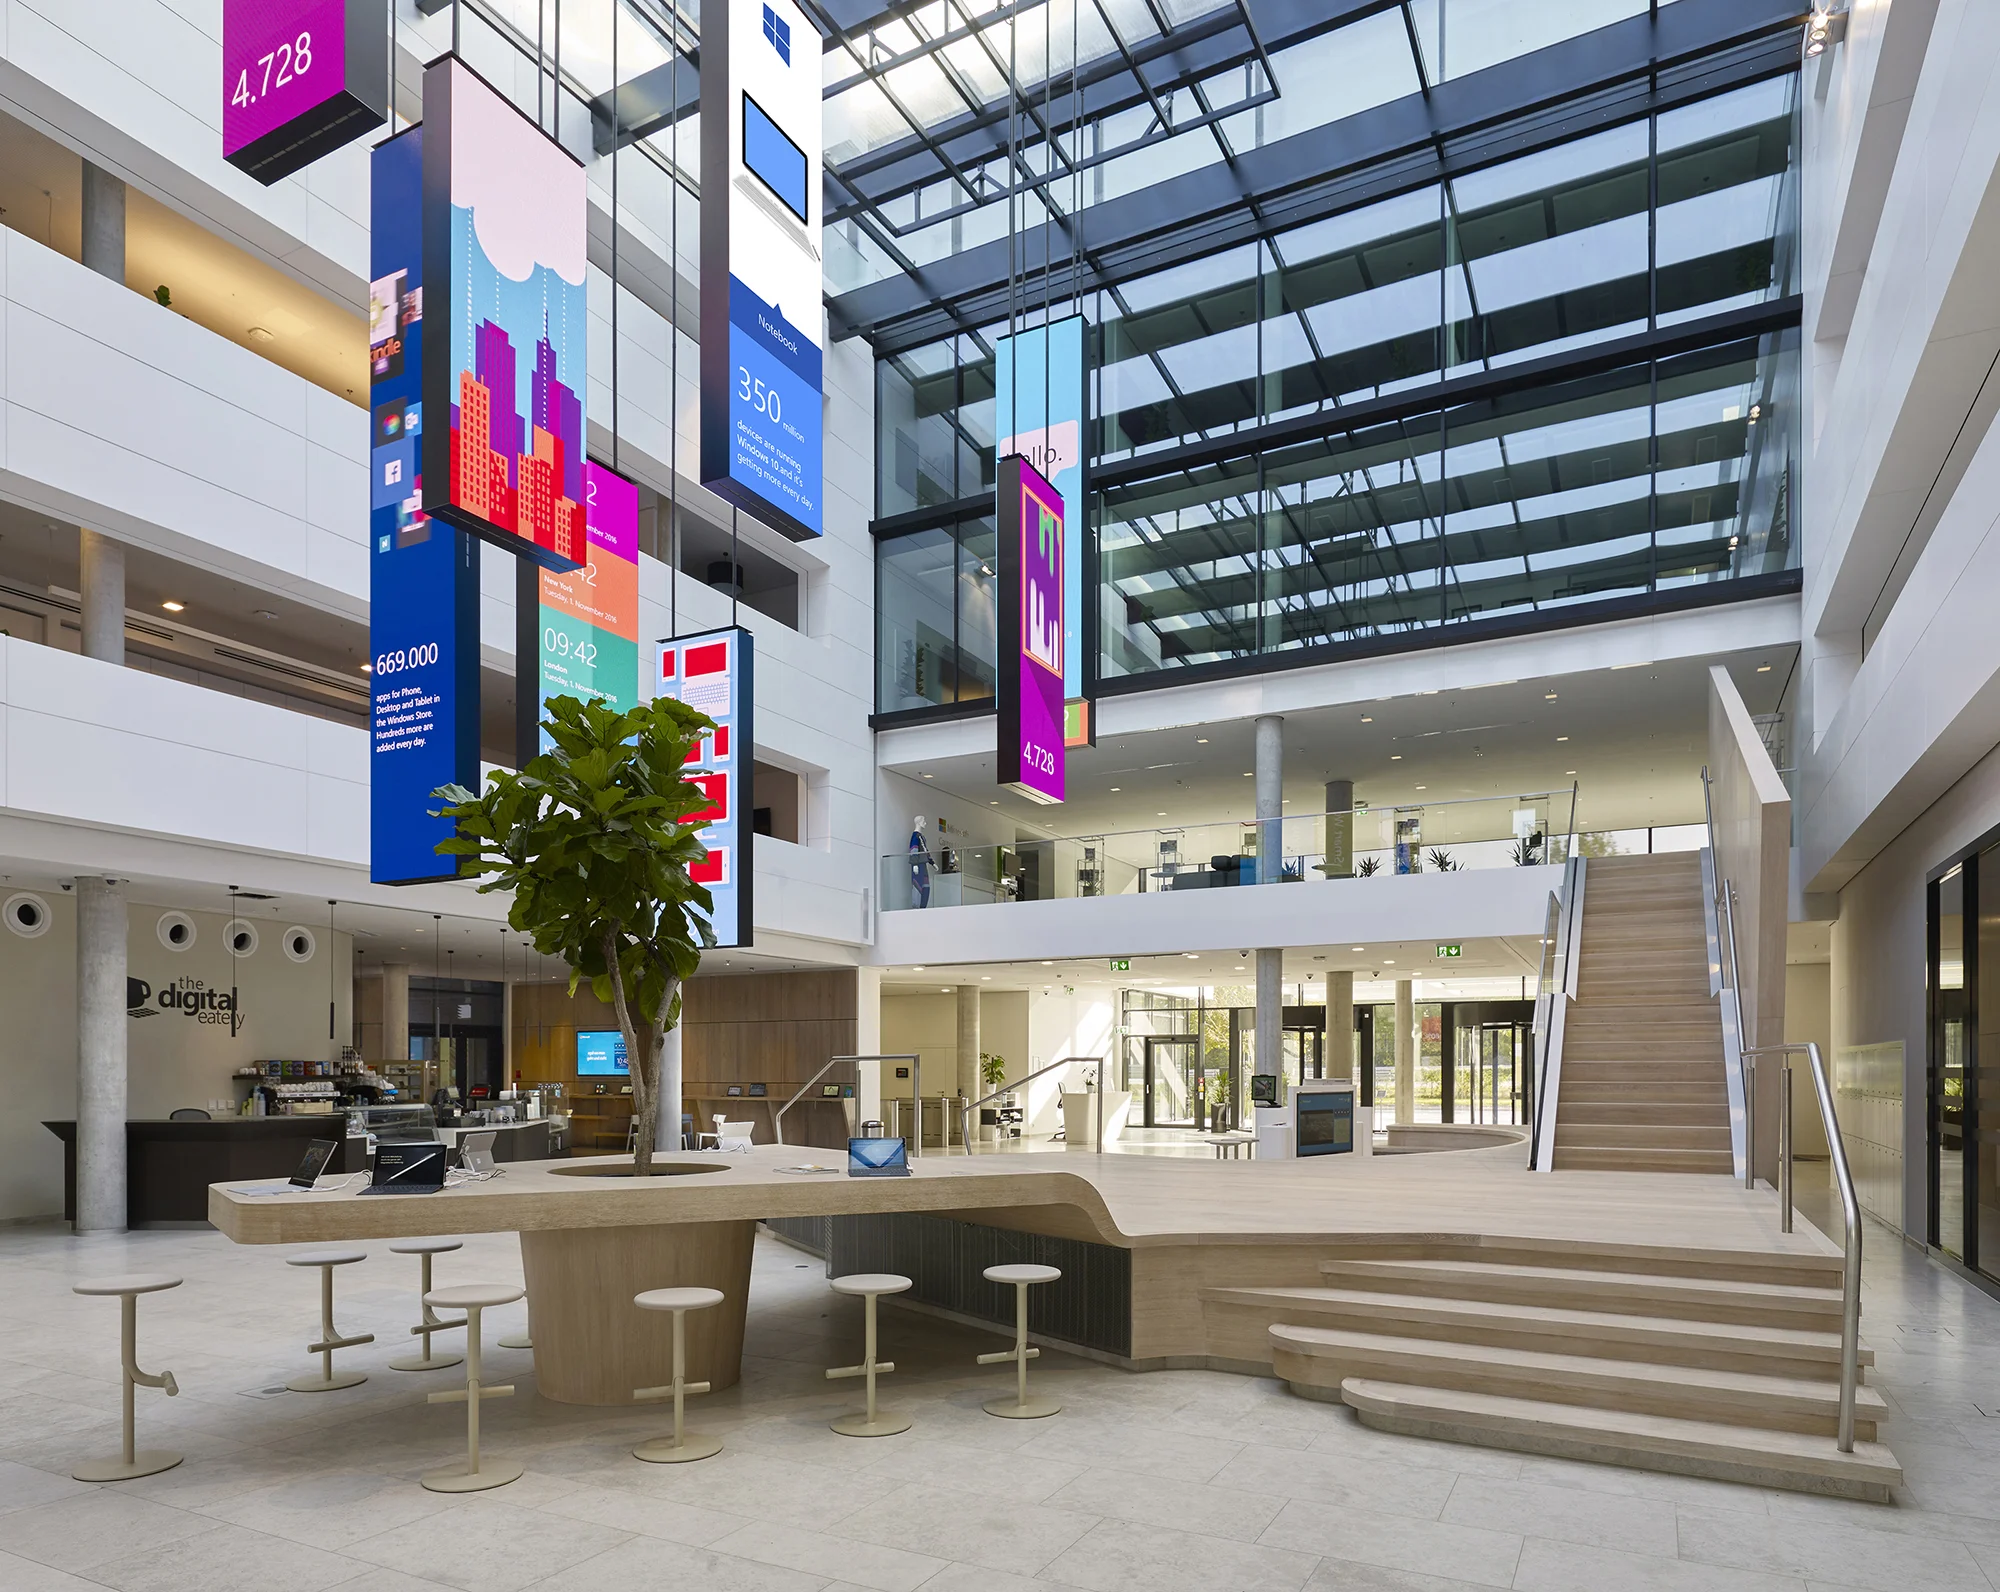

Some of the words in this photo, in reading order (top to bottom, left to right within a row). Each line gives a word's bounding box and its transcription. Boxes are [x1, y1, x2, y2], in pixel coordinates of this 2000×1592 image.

[231, 31, 312, 108] 4.728
[758, 313, 798, 356] Notebook
[738, 366, 781, 424] 350
[782, 422, 805, 444] million
[737, 420, 763, 445] devices
[763, 440, 775, 453] are
[776, 448, 802, 474] running
[737, 434, 769, 465] Windows
[793, 473, 804, 488] it's
[737, 453, 763, 478] getting
[763, 471, 782, 488] more
[782, 484, 801, 503] every
[800, 495, 815, 511] day.
[604, 532, 618, 544] 2016
[544, 574, 559, 587] New
[560, 581, 574, 594] York
[575, 599, 604, 618] November
[604, 612, 618, 624] 2016
[376, 642, 439, 676] 669.000
[544, 627, 598, 669] 09:42
[544, 659, 568, 674] London
[376, 693, 391, 703] apps
[391, 690, 401, 699] for
[401, 687, 423, 697] Phone,
[376, 703, 401, 715] Desktop
[401, 699, 414, 709] and
[414, 695, 433, 706] Tablet
[433, 694, 441, 703] in
[575, 682, 604, 699] November
[604, 692, 618, 704] 2016
[376, 718, 386, 727] the
[387, 714, 415, 725] Windows
[415, 711, 434, 720] Store.
[376, 727, 406, 740] Hundreds
[406, 725, 423, 735] more
[423, 723, 434, 731] are
[376, 741, 395, 753] added
[396, 740, 413, 750] every
[413, 737, 427, 748] day.
[1023, 741, 1055, 776] 4.728
[179, 976, 204, 990] the
[158, 983, 238, 1016] digital
[198, 1010, 246, 1030] eatey
